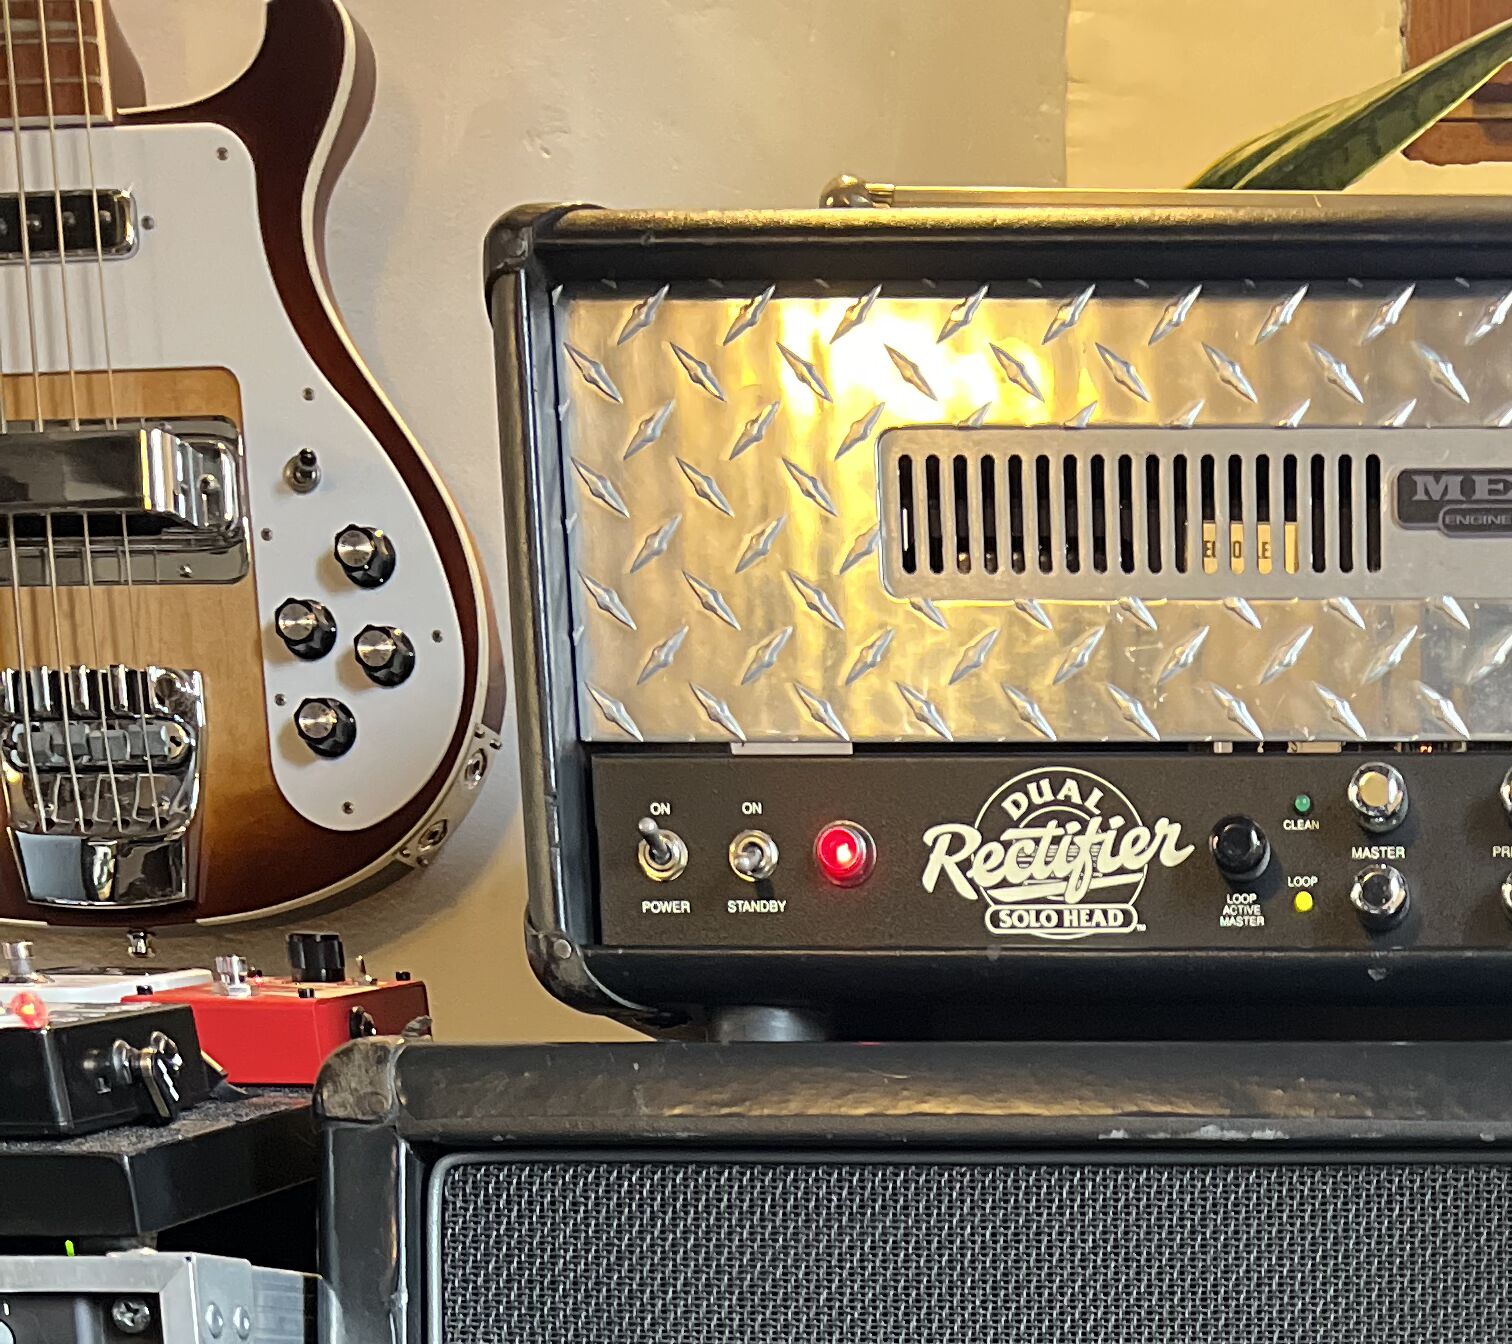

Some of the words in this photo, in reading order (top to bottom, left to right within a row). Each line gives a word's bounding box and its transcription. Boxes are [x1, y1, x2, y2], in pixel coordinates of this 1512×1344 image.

[1001, 778, 1104, 822] DUAL
[650, 802, 671, 815] ON
[741, 801, 762, 815] ON
[1282, 820, 1320, 831] CLEAN
[922, 815, 1196, 904] Rectifier
[1351, 846, 1406, 860] MASTER
[1287, 876, 1318, 888] LOOP
[1226, 894, 1257, 905] LOOP
[642, 901, 691, 914] POWER
[727, 900, 787, 913] STANDBY
[1222, 905, 1262, 916] ACTIVE
[999, 909, 1060, 928] SOLO
[1063, 908, 1124, 928] HEAD
[1219, 916, 1265, 928] MASTER
